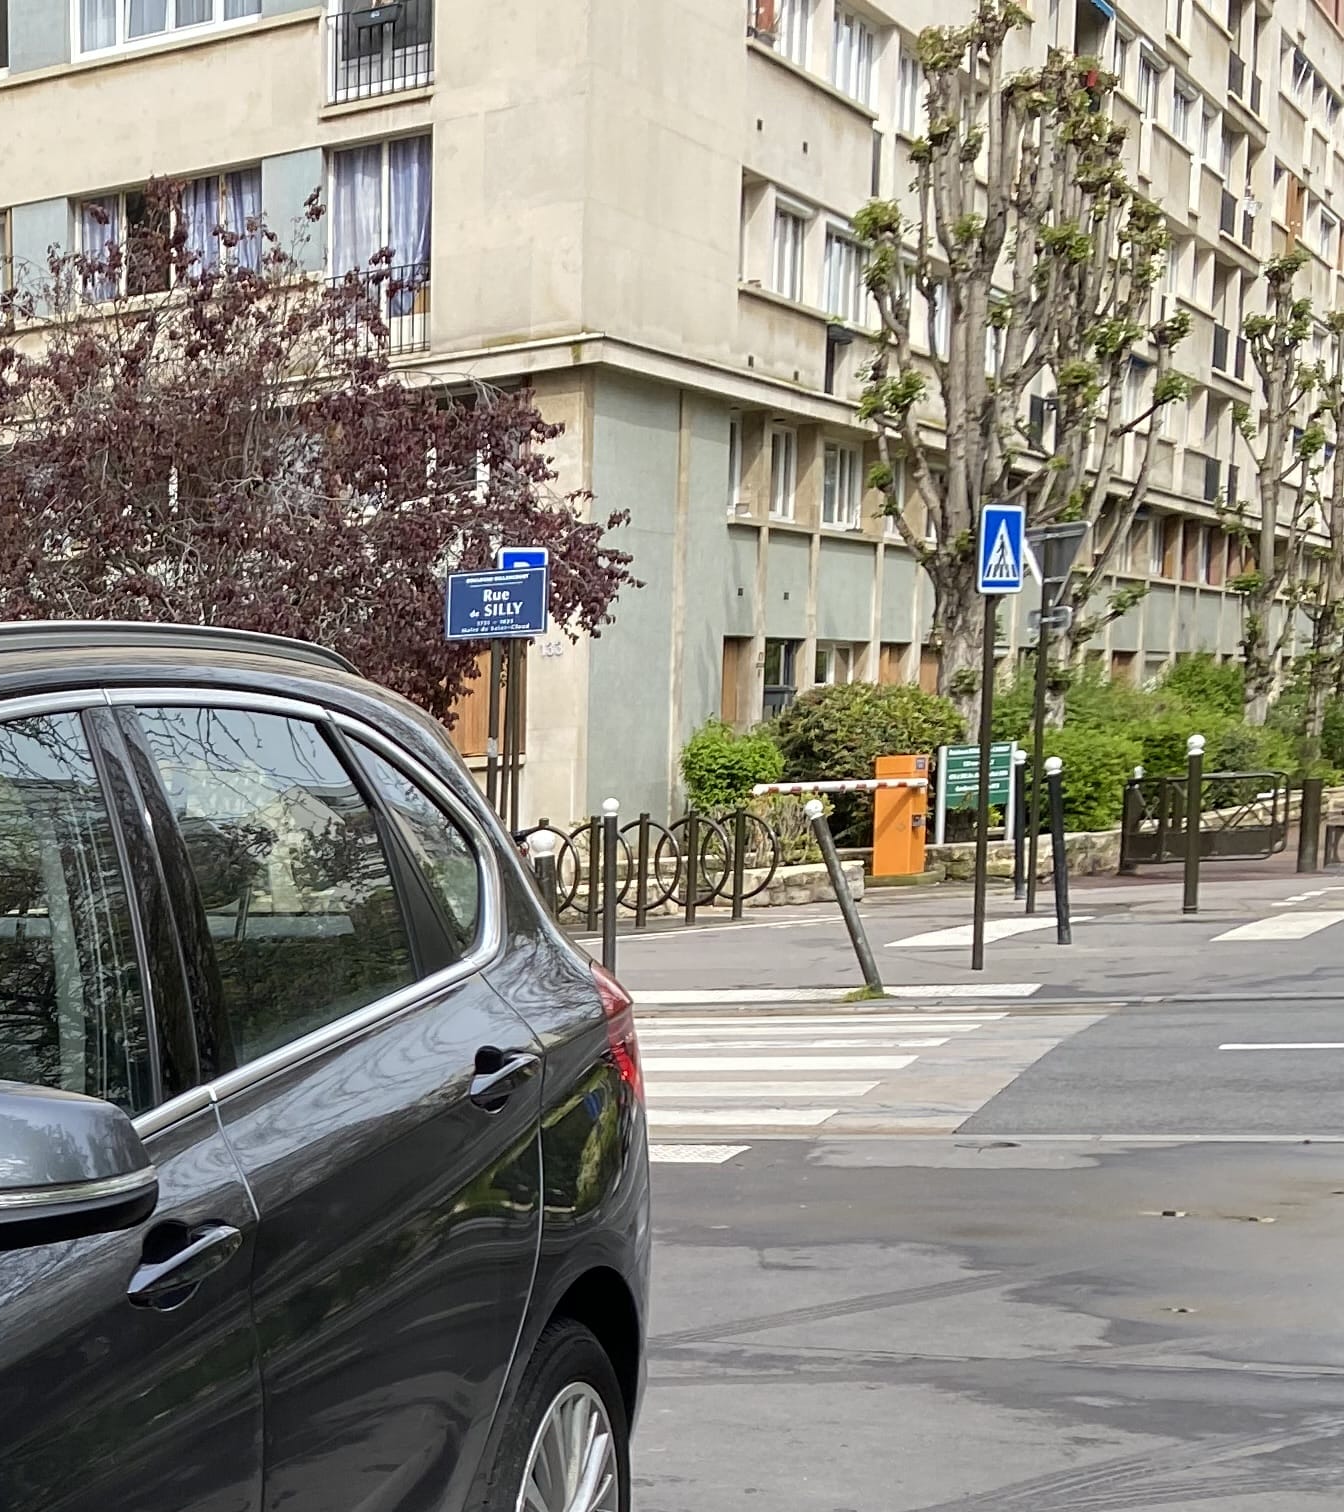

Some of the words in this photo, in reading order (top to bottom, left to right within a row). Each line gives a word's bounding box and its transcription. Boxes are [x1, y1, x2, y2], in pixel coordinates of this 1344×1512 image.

[483, 589, 510, 602] Rue
[469, 609, 480, 618] de
[484, 602, 523, 617] SILLY
